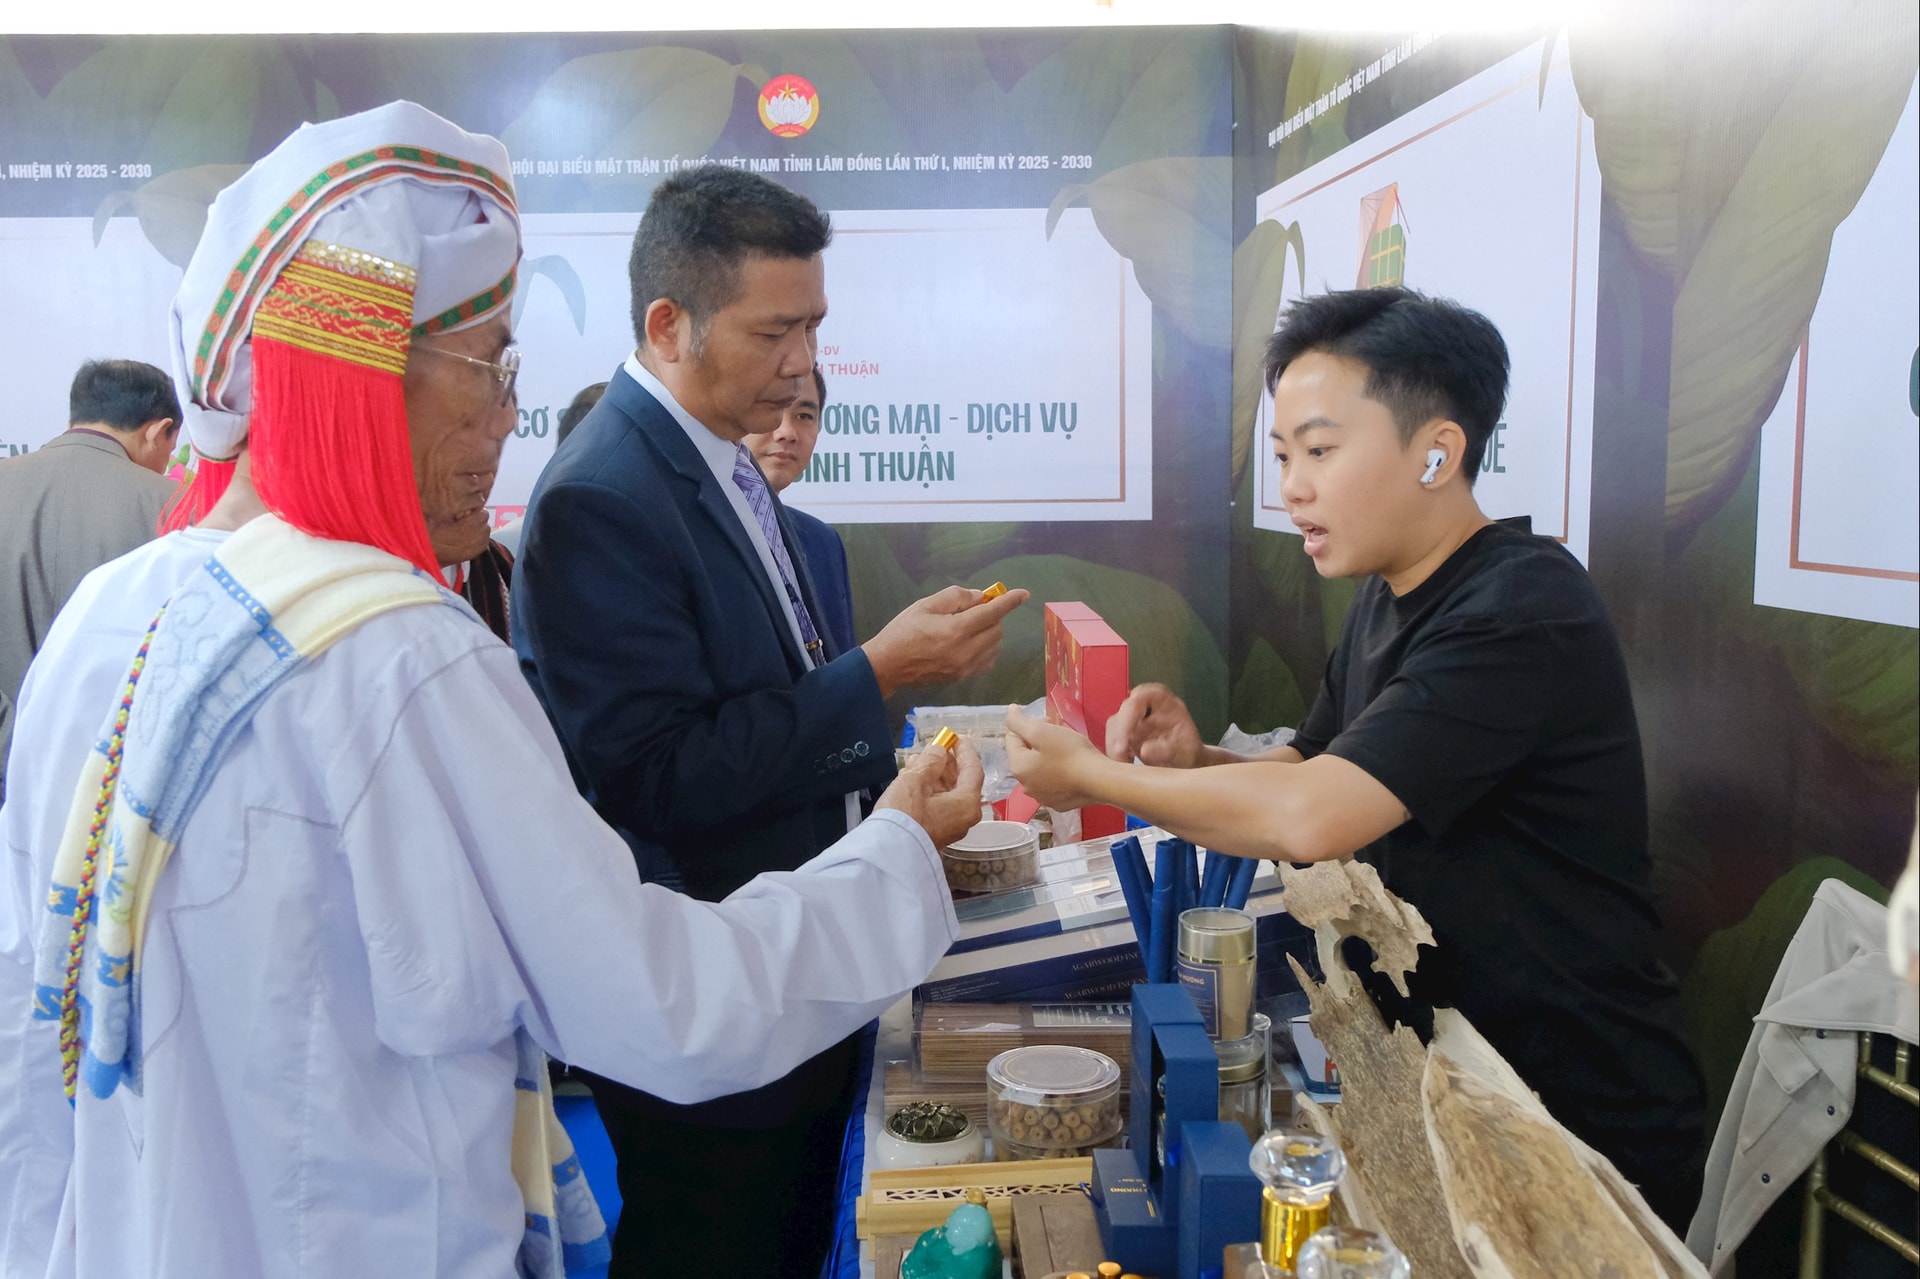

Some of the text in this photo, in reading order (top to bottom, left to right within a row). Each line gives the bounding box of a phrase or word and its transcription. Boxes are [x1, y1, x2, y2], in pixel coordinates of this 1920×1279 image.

[1352, 68, 1365, 93] VIỆT
[1366, 59, 1380, 84] NAM
[9, 161, 52, 181] NHIỆM
[55, 161, 72, 178] KỲ
[76, 164, 108, 178] 2025
[120, 164, 152, 178] 2030
[512, 158, 534, 178] HỘI
[538, 160, 558, 178] ĐẠI
[562, 155, 592, 175] BIỂU
[595, 157, 622, 177] MẶT
[626, 157, 660, 177] TRẬN
[663, 154, 679, 172] TỔ
[749, 158, 780, 172] NAM
[783, 153, 813, 172] TỈNH
[816, 153, 843, 172] LÂM
[847, 152, 882, 171] ĐỒNG
[885, 152, 910, 171] LẦN
[914, 153, 939, 171] THỨ
[942, 156, 950, 172] I,
[953, 153, 995, 173] NHIỆM
[998, 153, 1015, 170] KỲ
[1018, 155, 1049, 169] 2025
[1061, 154, 1093, 169] 2030
[828, 360, 879, 378] THUẬN
[514, 405, 549, 438] CƠ
[889, 404, 941, 442] MẠI
[967, 402, 1031, 441] DỊCH
[1040, 402, 1078, 440] VỤ
[859, 442, 955, 489] THUẬN
[1072, 955, 1123, 972] AGARWOOD
